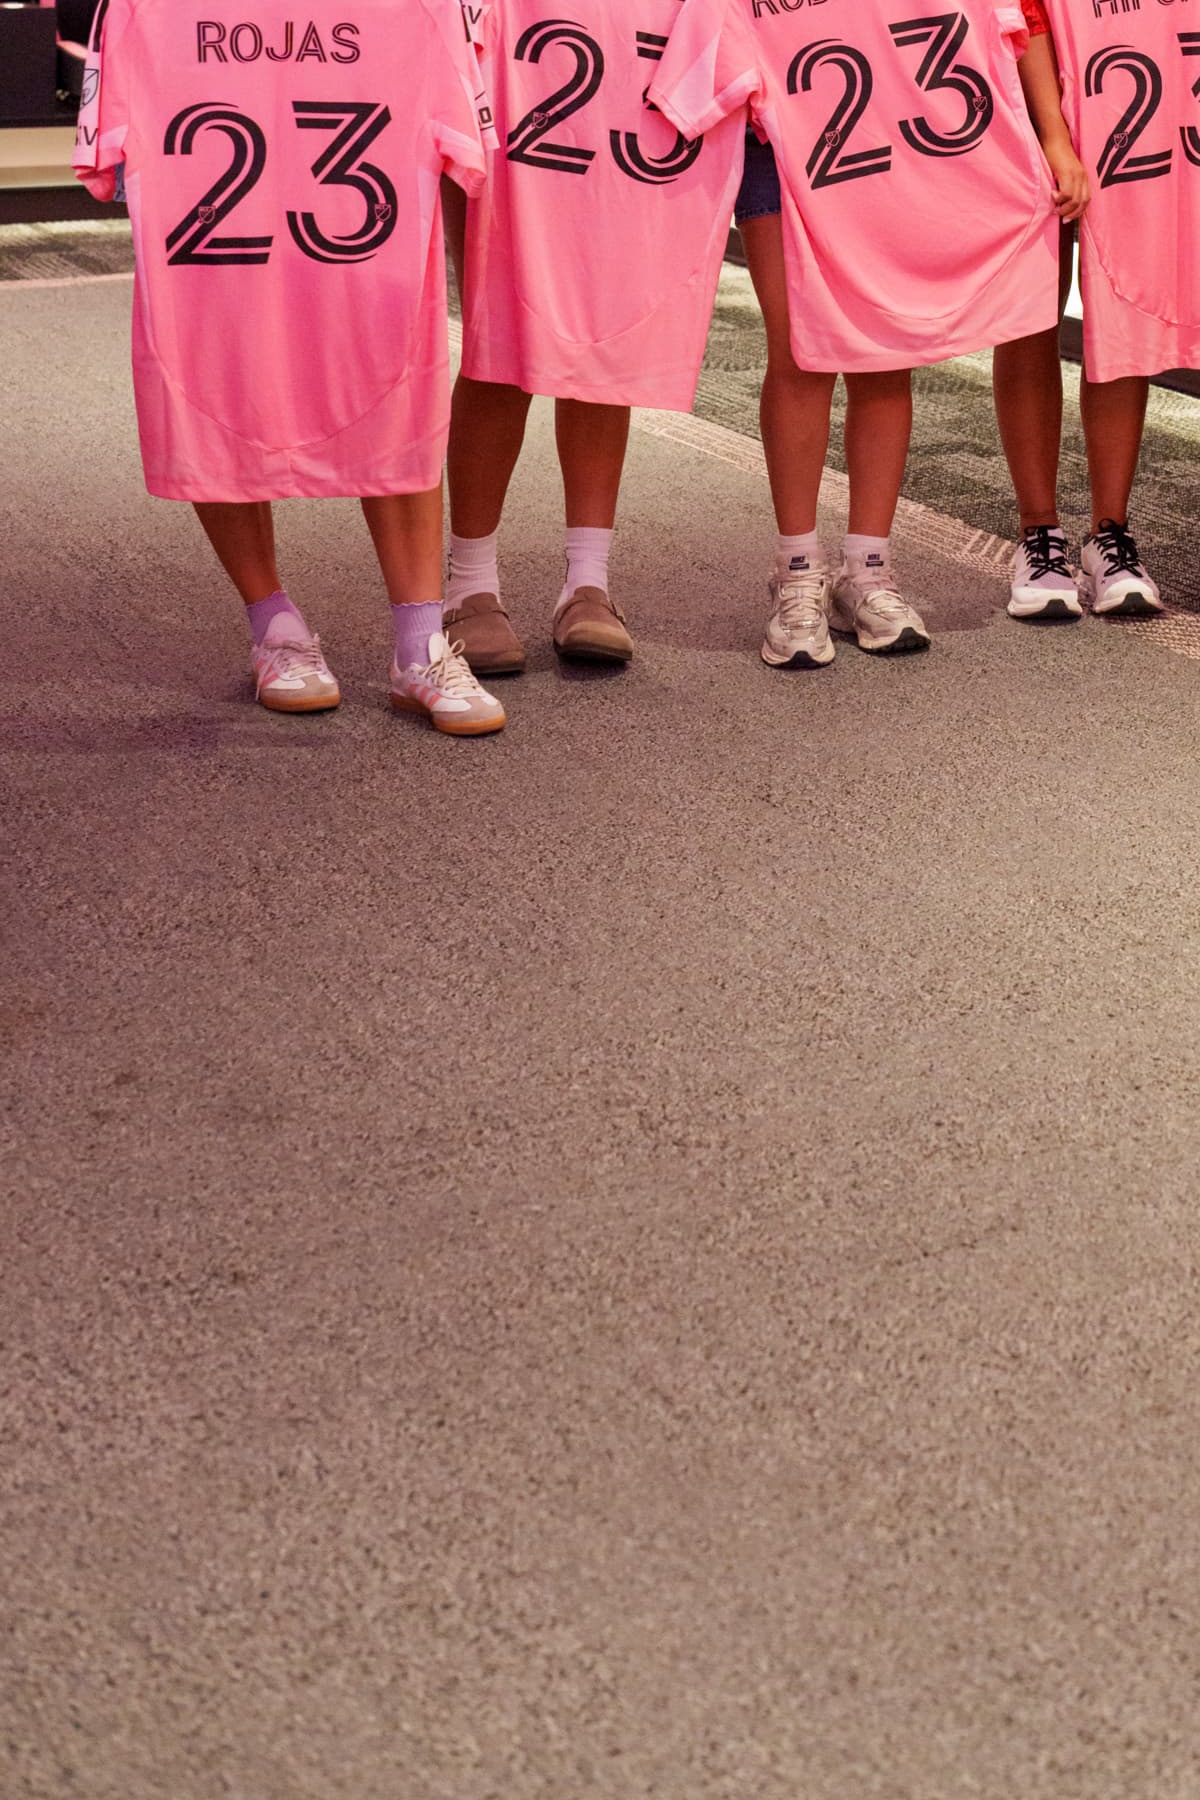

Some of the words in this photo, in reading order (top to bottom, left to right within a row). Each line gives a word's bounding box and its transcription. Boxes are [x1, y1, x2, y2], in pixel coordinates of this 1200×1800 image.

[196, 20, 361, 64] ROJAS
[506, 19, 704, 185] 23
[787, 12, 994, 190] 23
[163, 101, 398, 266] 23
